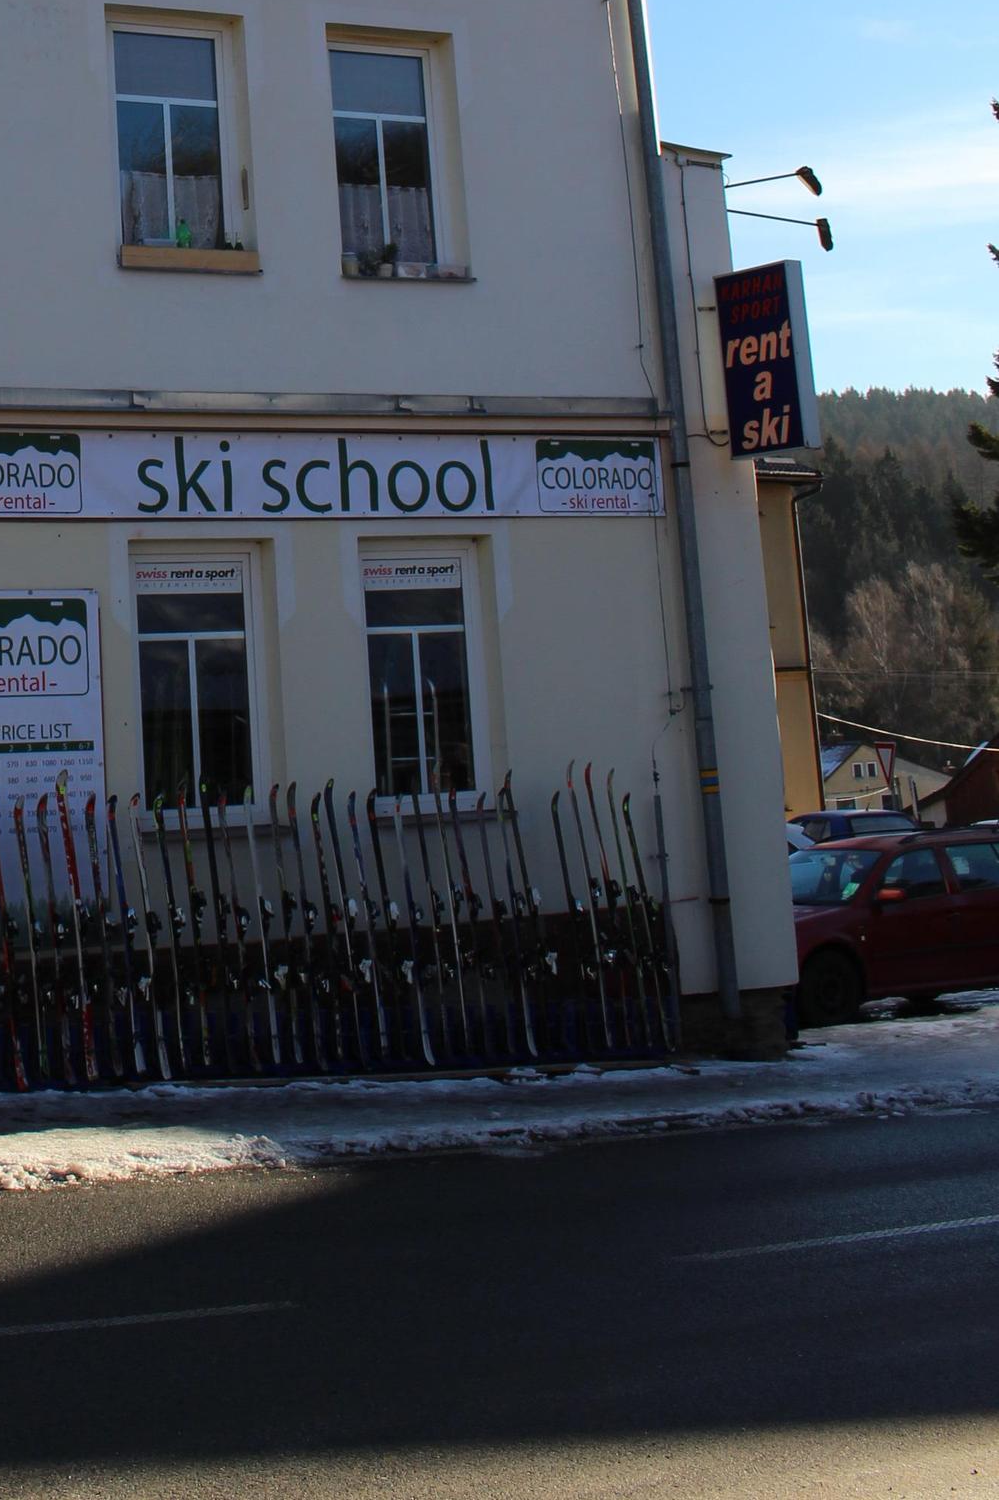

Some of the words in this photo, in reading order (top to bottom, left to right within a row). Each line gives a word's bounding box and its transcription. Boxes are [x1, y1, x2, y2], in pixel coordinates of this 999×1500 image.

[731, 296, 780, 325] SPORT
[725, 319, 791, 369] rent
[753, 370, 773, 401] a
[742, 405, 791, 450] ski
[136, 436, 232, 513] ski
[261, 437, 496, 513] school
[541, 466, 653, 491] COLORADO
[135, 567, 168, 580] swiss
[170, 568, 194, 579] rent
[195, 570, 203, 578] a
[205, 568, 235, 582] sport
[363, 564, 392, 576] swiss
[395, 565, 416, 575] rent
[418, 567, 425, 575] a
[427, 564, 454, 577] sport
[40, 723, 72, 739] LIST
